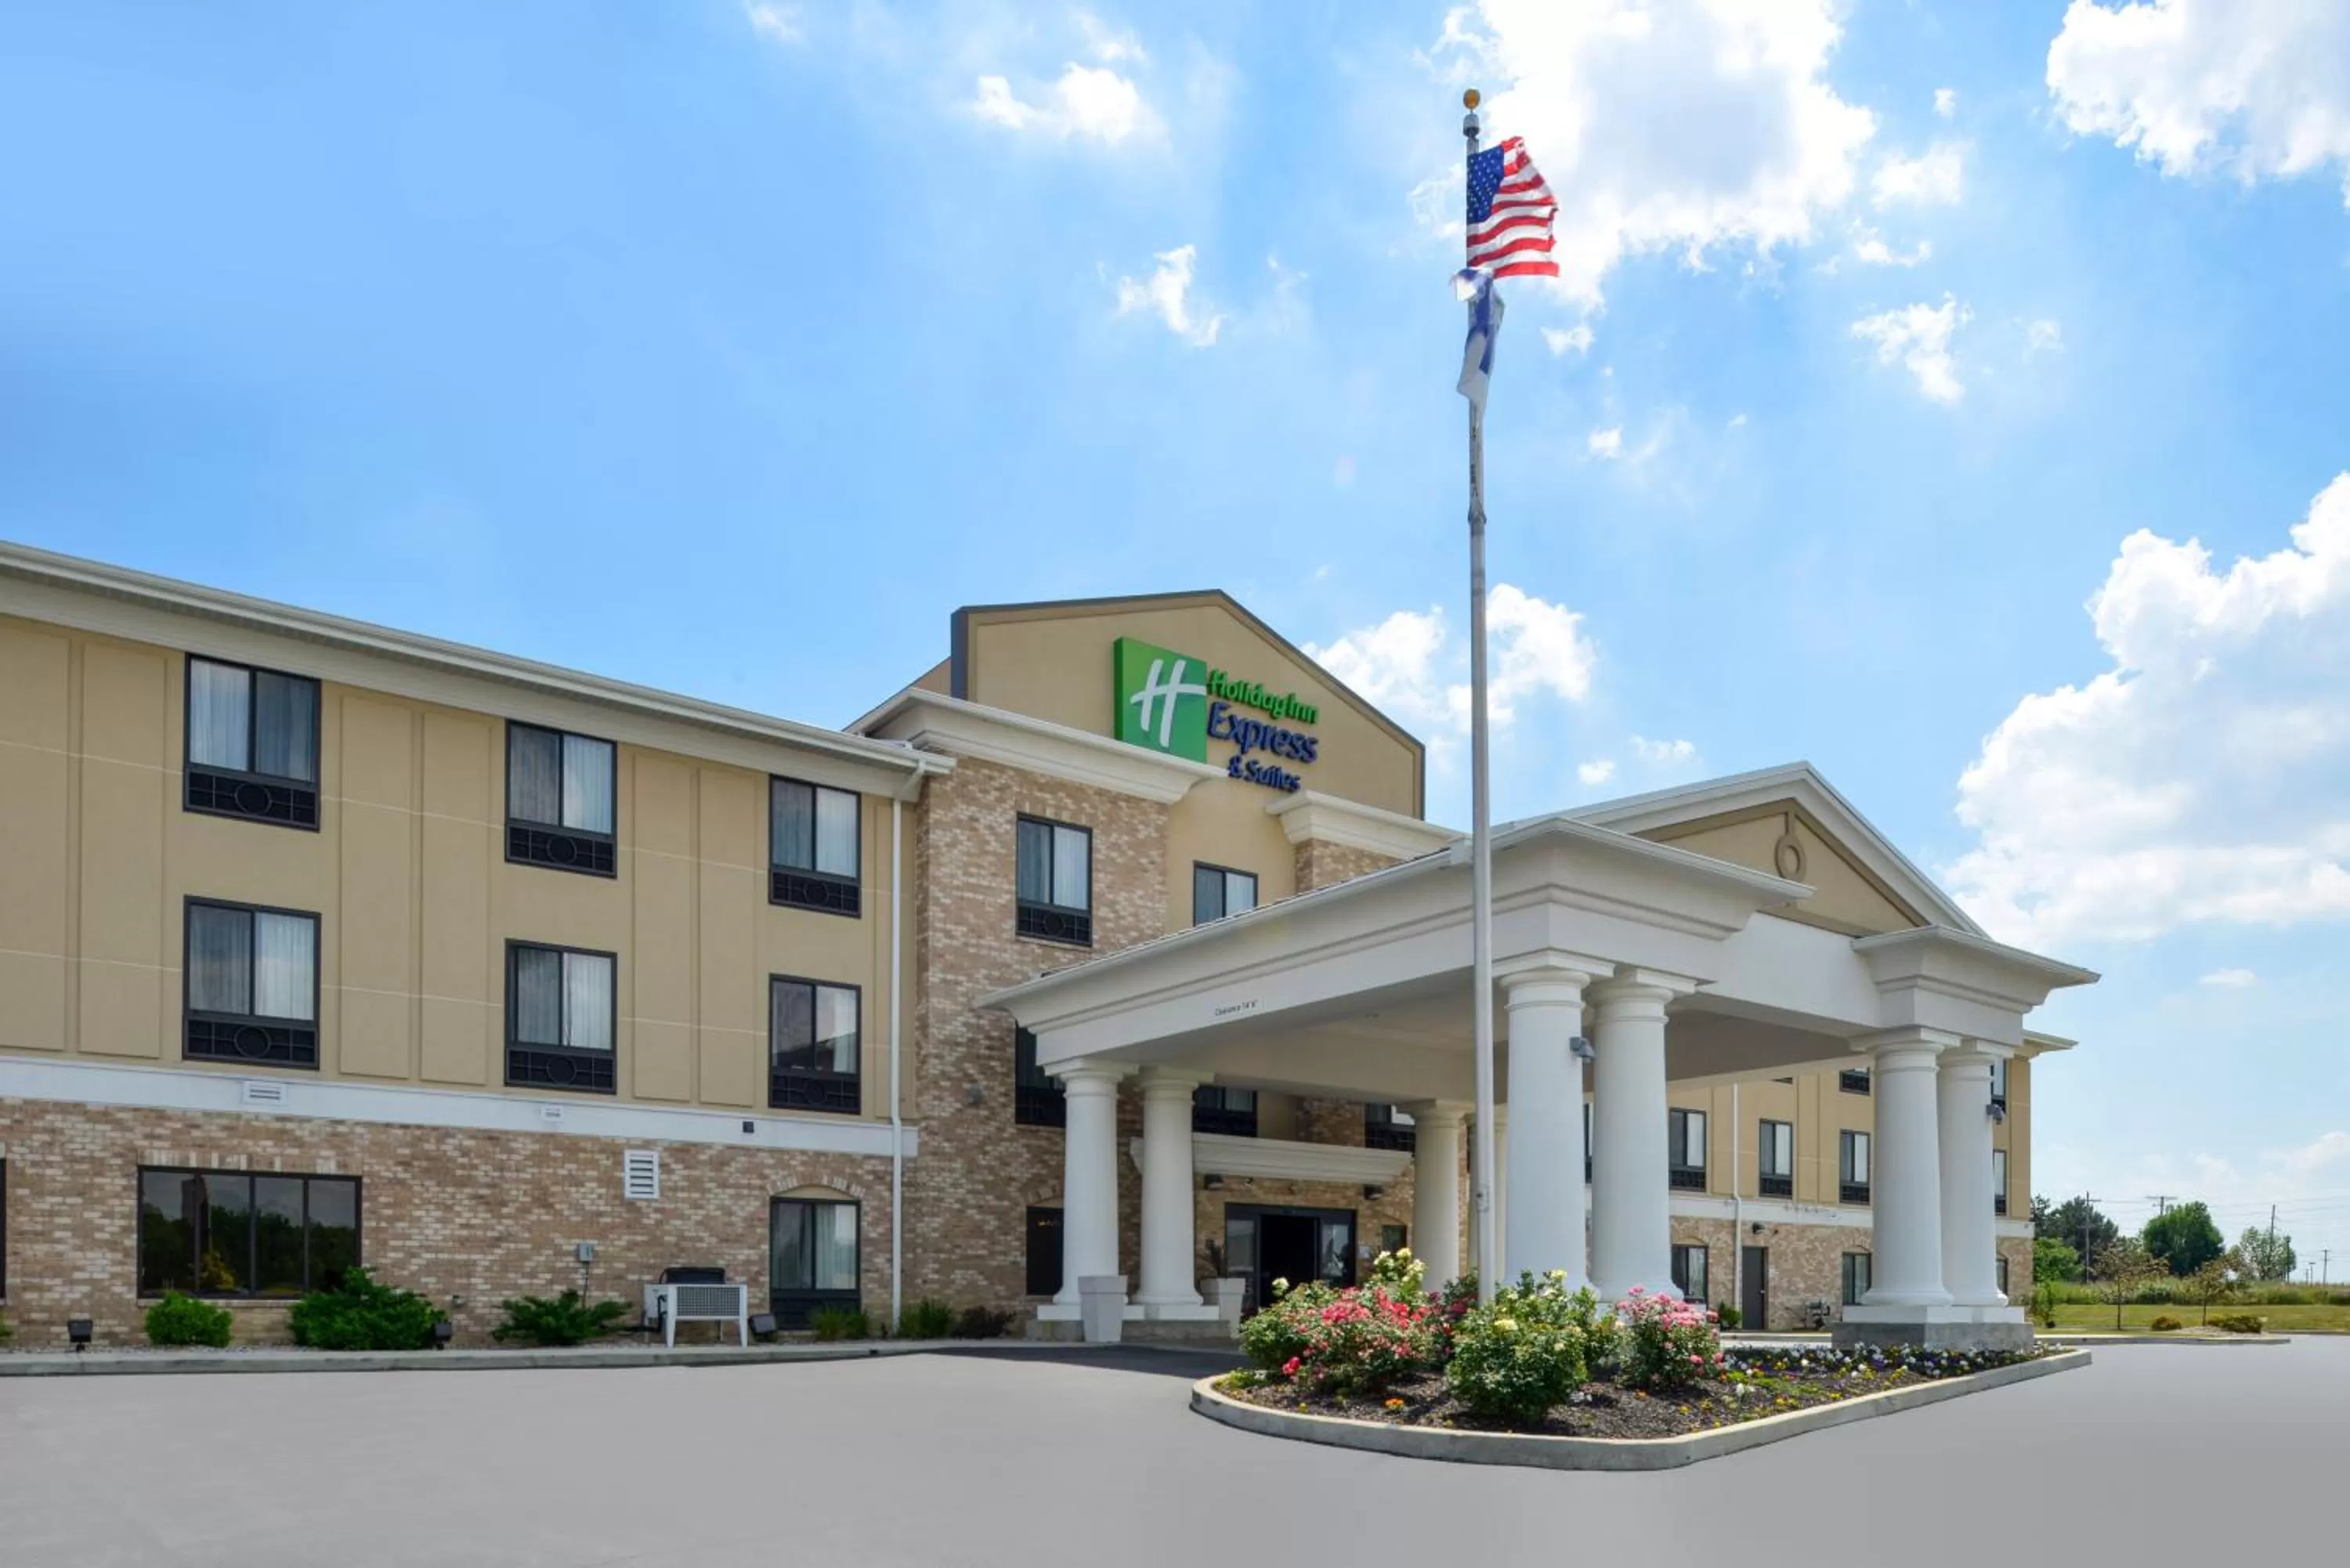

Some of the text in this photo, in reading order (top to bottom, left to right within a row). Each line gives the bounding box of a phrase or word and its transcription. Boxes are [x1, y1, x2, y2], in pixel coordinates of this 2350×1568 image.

[1207, 669, 1318, 724] Holiday Inn
[1207, 701, 1318, 764] Express
[1228, 754, 1301, 793] & Suites
